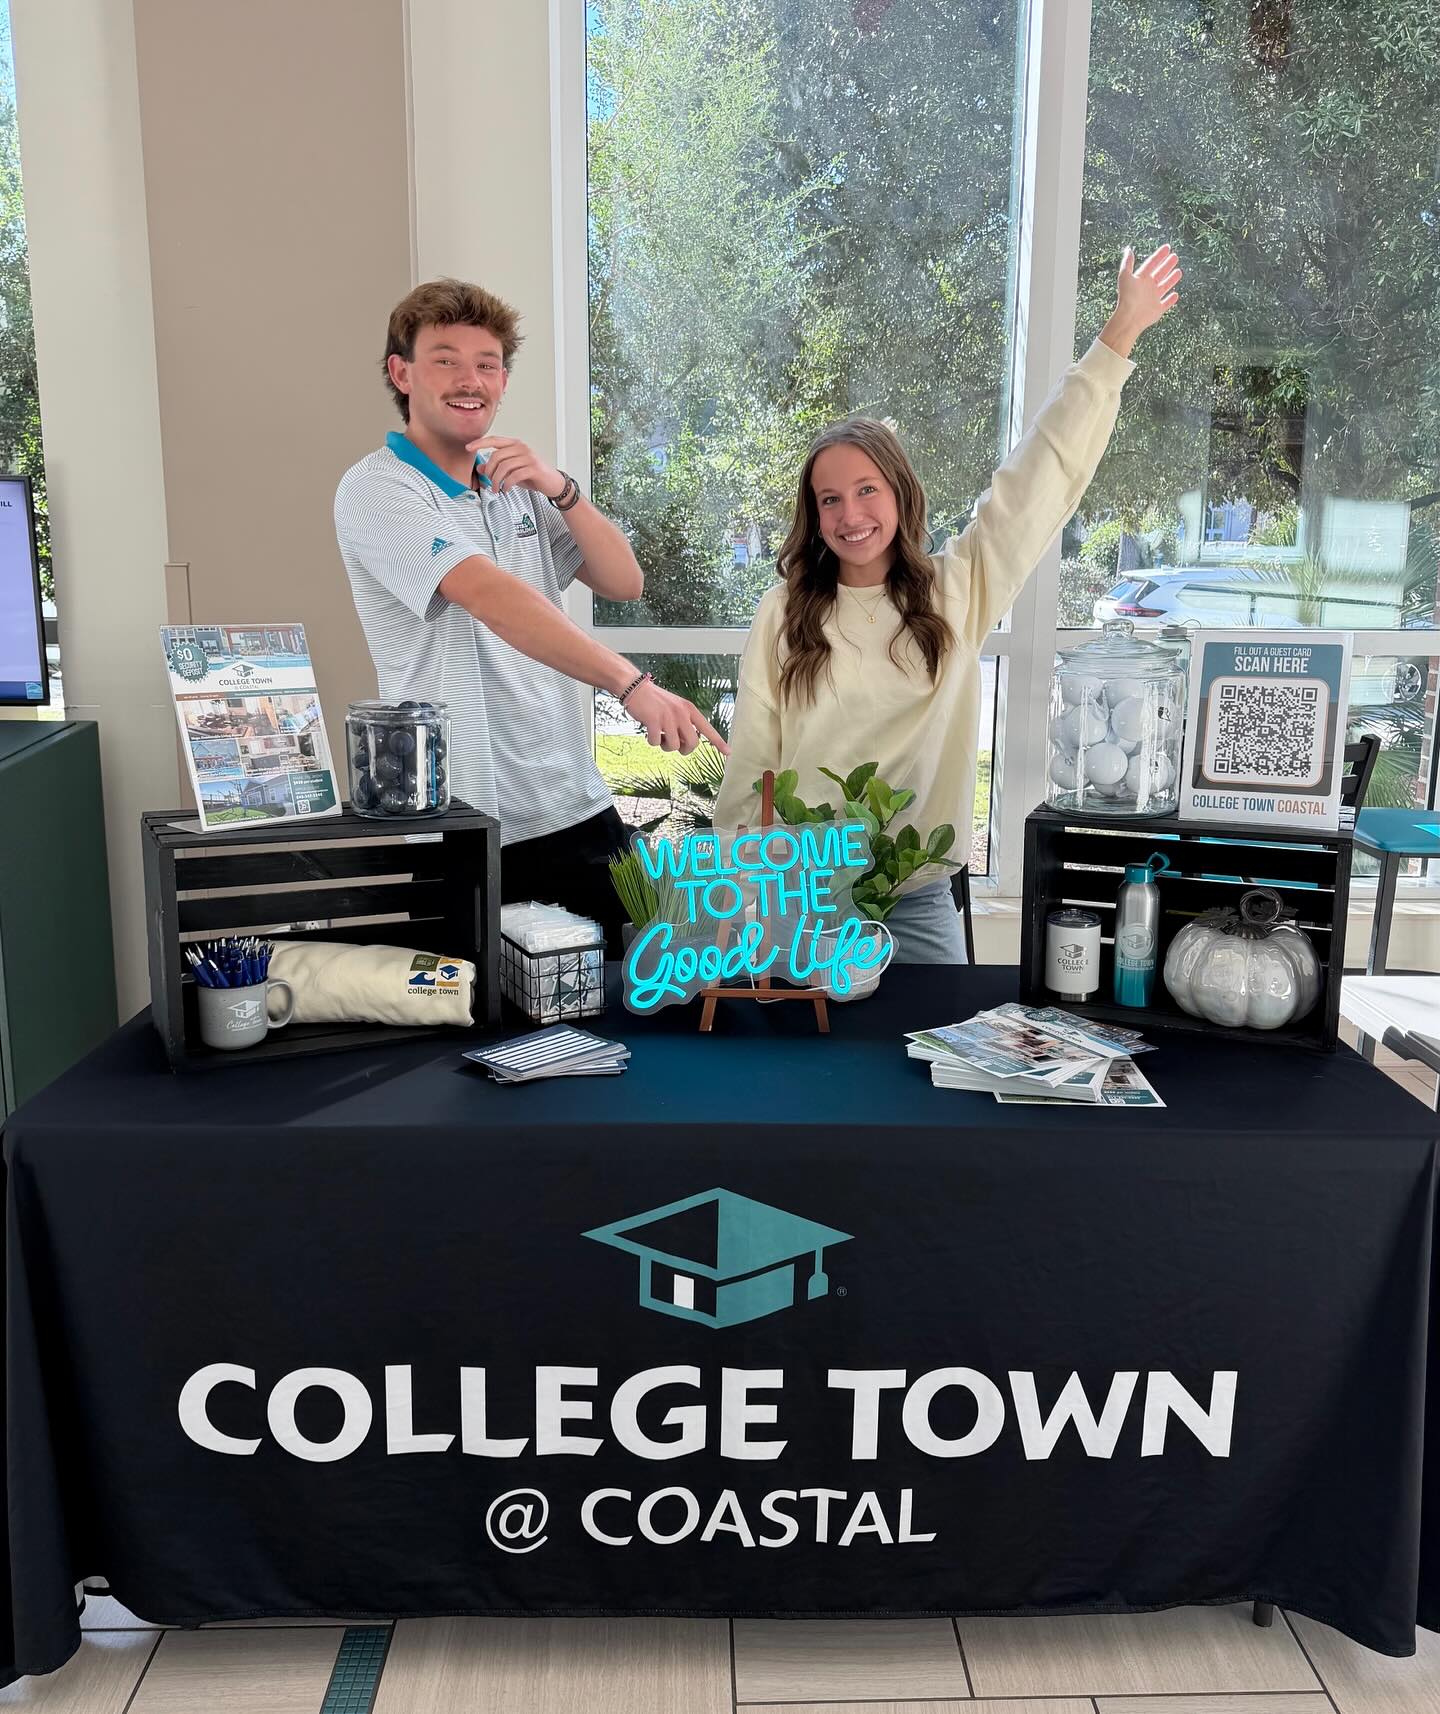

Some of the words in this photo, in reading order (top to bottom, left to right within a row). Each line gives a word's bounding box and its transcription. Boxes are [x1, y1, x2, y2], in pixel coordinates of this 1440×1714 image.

[176, 647, 193, 662] $0
[1234, 646, 1248, 656] FILL
[1248, 646, 1263, 656] OUT
[1263, 647, 1269, 656] A
[1269, 647, 1292, 657] GUEST
[1292, 647, 1312, 657] CARD
[178, 660, 203, 670] SECURITY
[182, 668, 204, 677] DEPOSIT
[1234, 656, 1270, 673] SCAN
[1273, 657, 1309, 674] HERE
[218, 678, 250, 687] COLLEGE
[251, 677, 273, 686] TOWN
[1192, 794, 1240, 810] COLLEGE
[1242, 797, 1275, 812] TOWN
[1277, 799, 1327, 815] COASTAL
[636, 823, 869, 880] WELCOME
[673, 878, 744, 924] TO
[747, 869, 838, 918] THE
[628, 921, 781, 1010] Good
[1057, 957, 1089, 966] COLLEGE
[407, 986, 438, 997] college
[439, 988, 459, 996] town
[177, 1362, 788, 1463] COLLEGE
[827, 1368, 1239, 1461] TOWN
[485, 1487, 549, 1554] @
[580, 1486, 937, 1548] COASTAL
